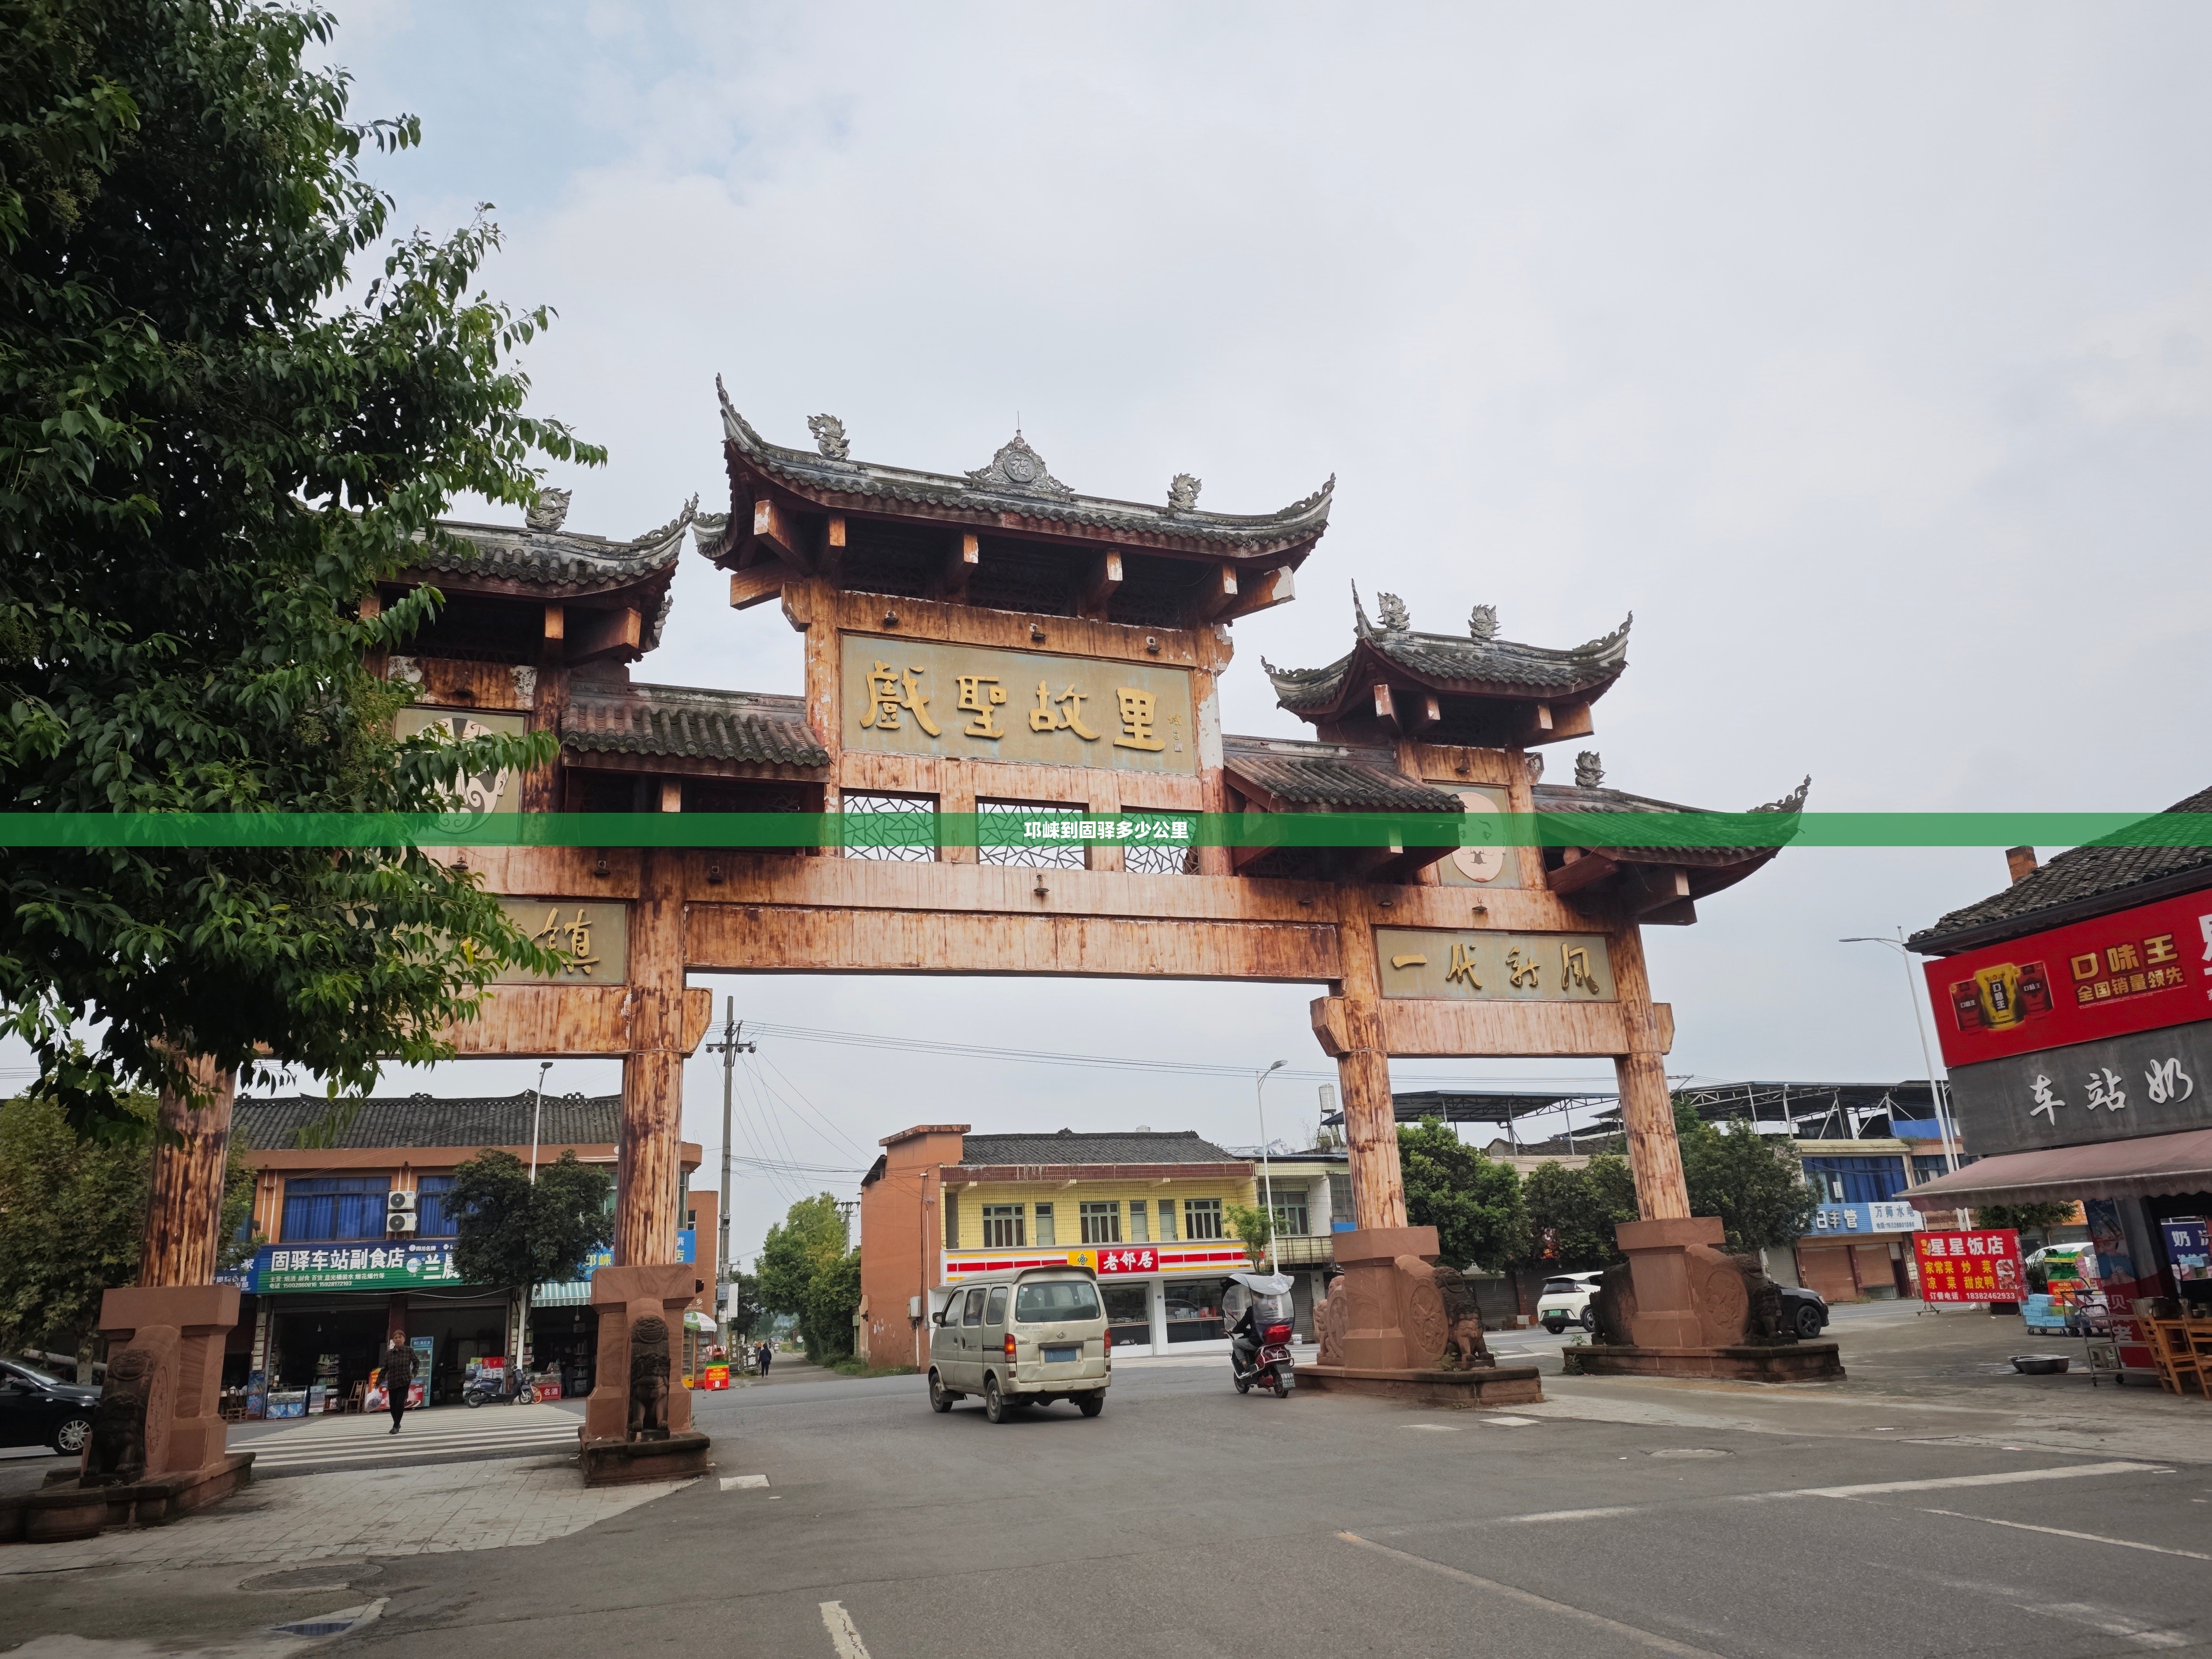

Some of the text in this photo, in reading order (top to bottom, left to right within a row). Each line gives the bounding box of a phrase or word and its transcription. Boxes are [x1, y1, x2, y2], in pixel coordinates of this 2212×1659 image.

[2071, 934, 2177, 981] 口味王
[2077, 967, 2183, 1002] 全国销量领先
[1992, 983, 2006, 1009] 口味王
[2030, 1057, 2194, 1126] 车站奶
[1931, 1236, 2004, 1256] 星星饭店
[271, 1247, 405, 1272] 固驿车站副食店
[1103, 1251, 1154, 1271] 老邻居
[1924, 1260, 1954, 1274] 家常菜
[1964, 1276, 1995, 1290] 甜皮鸭
[544, 1387, 558, 1397] 名酒
